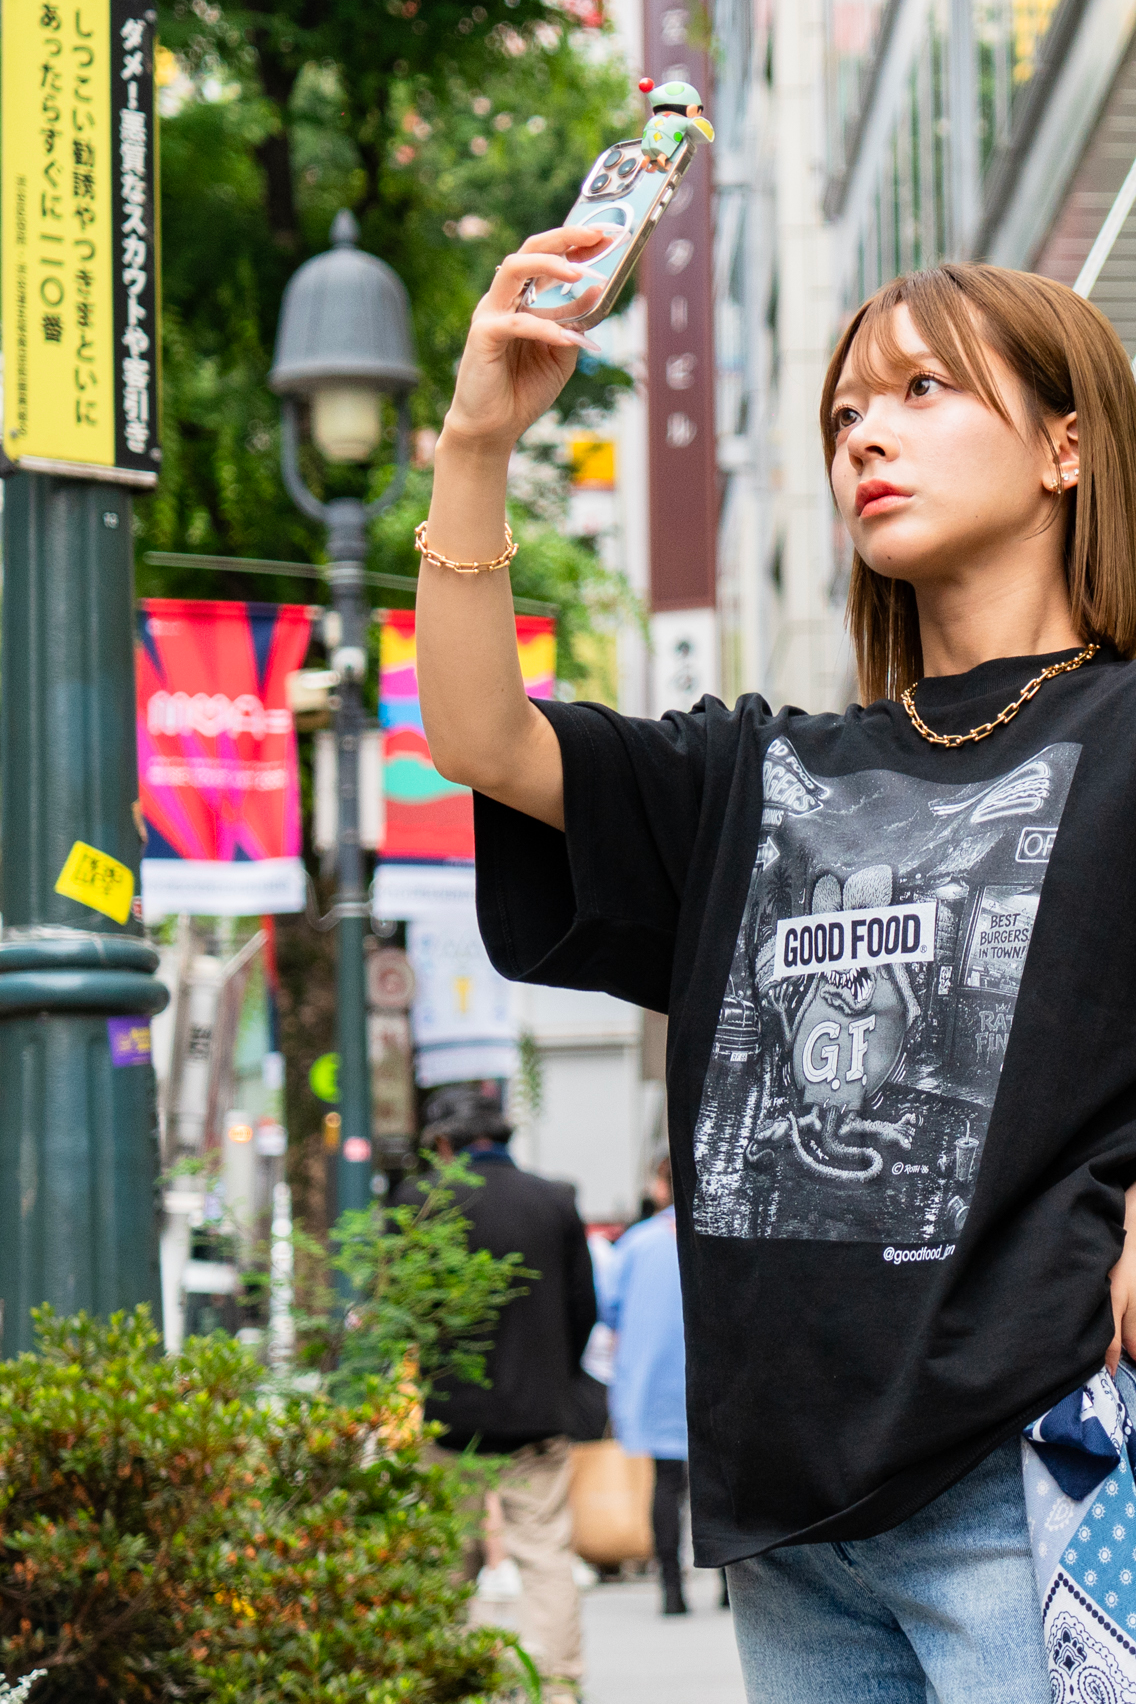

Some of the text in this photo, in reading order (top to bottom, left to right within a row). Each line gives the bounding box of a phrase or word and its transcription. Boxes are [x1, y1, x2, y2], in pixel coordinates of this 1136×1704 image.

[990, 913, 1021, 929] BEST
[783, 922, 844, 968] GOOD
[980, 928, 1030, 946] BURGERS
[978, 946, 1026, 959] IN TOWN!
